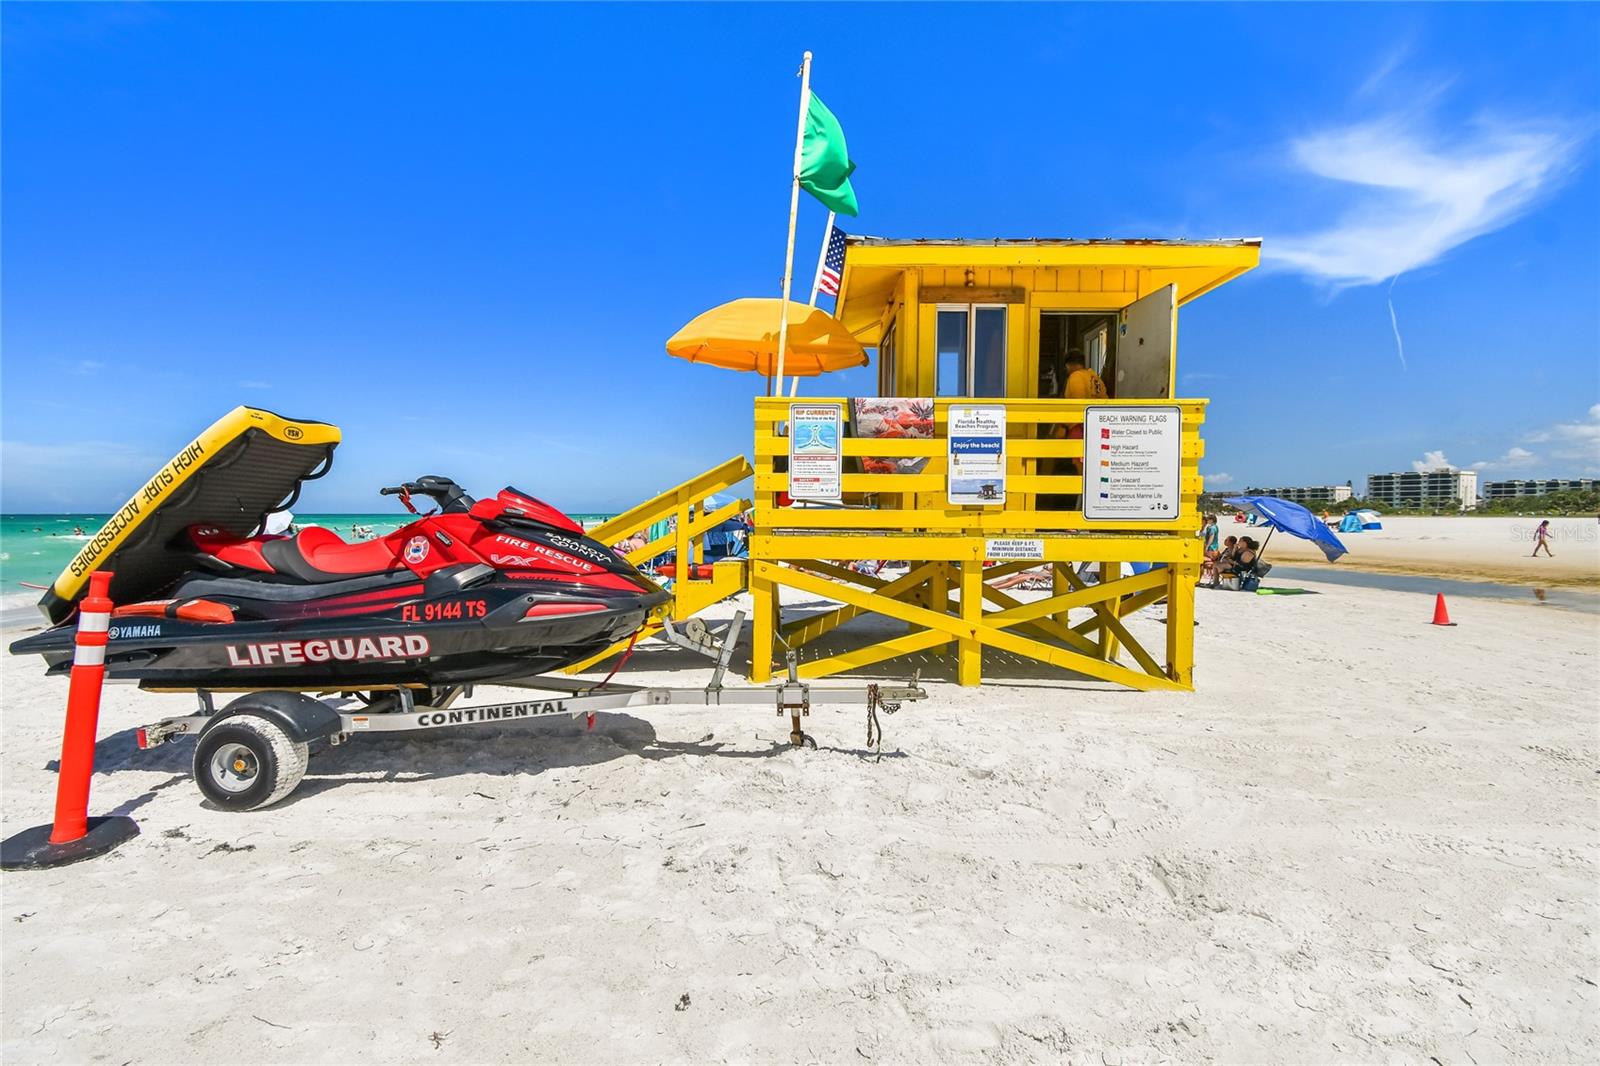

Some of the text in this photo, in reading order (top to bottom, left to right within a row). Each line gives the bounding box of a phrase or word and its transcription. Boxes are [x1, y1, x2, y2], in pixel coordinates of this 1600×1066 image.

[1099, 415, 1167, 423] BEACH WARNING FLAGS
[70, 440, 205, 577] HIGH SURF ACCESSORIES
[490, 553, 539, 567] VX
[496, 535, 593, 571] FIRE RESCUE
[402, 600, 486, 622] FL 9144 TS
[119, 624, 161, 638] YAMAHA
[226, 634, 430, 666] LIFEGUARD
[418, 701, 568, 727] CONTINENTAL
